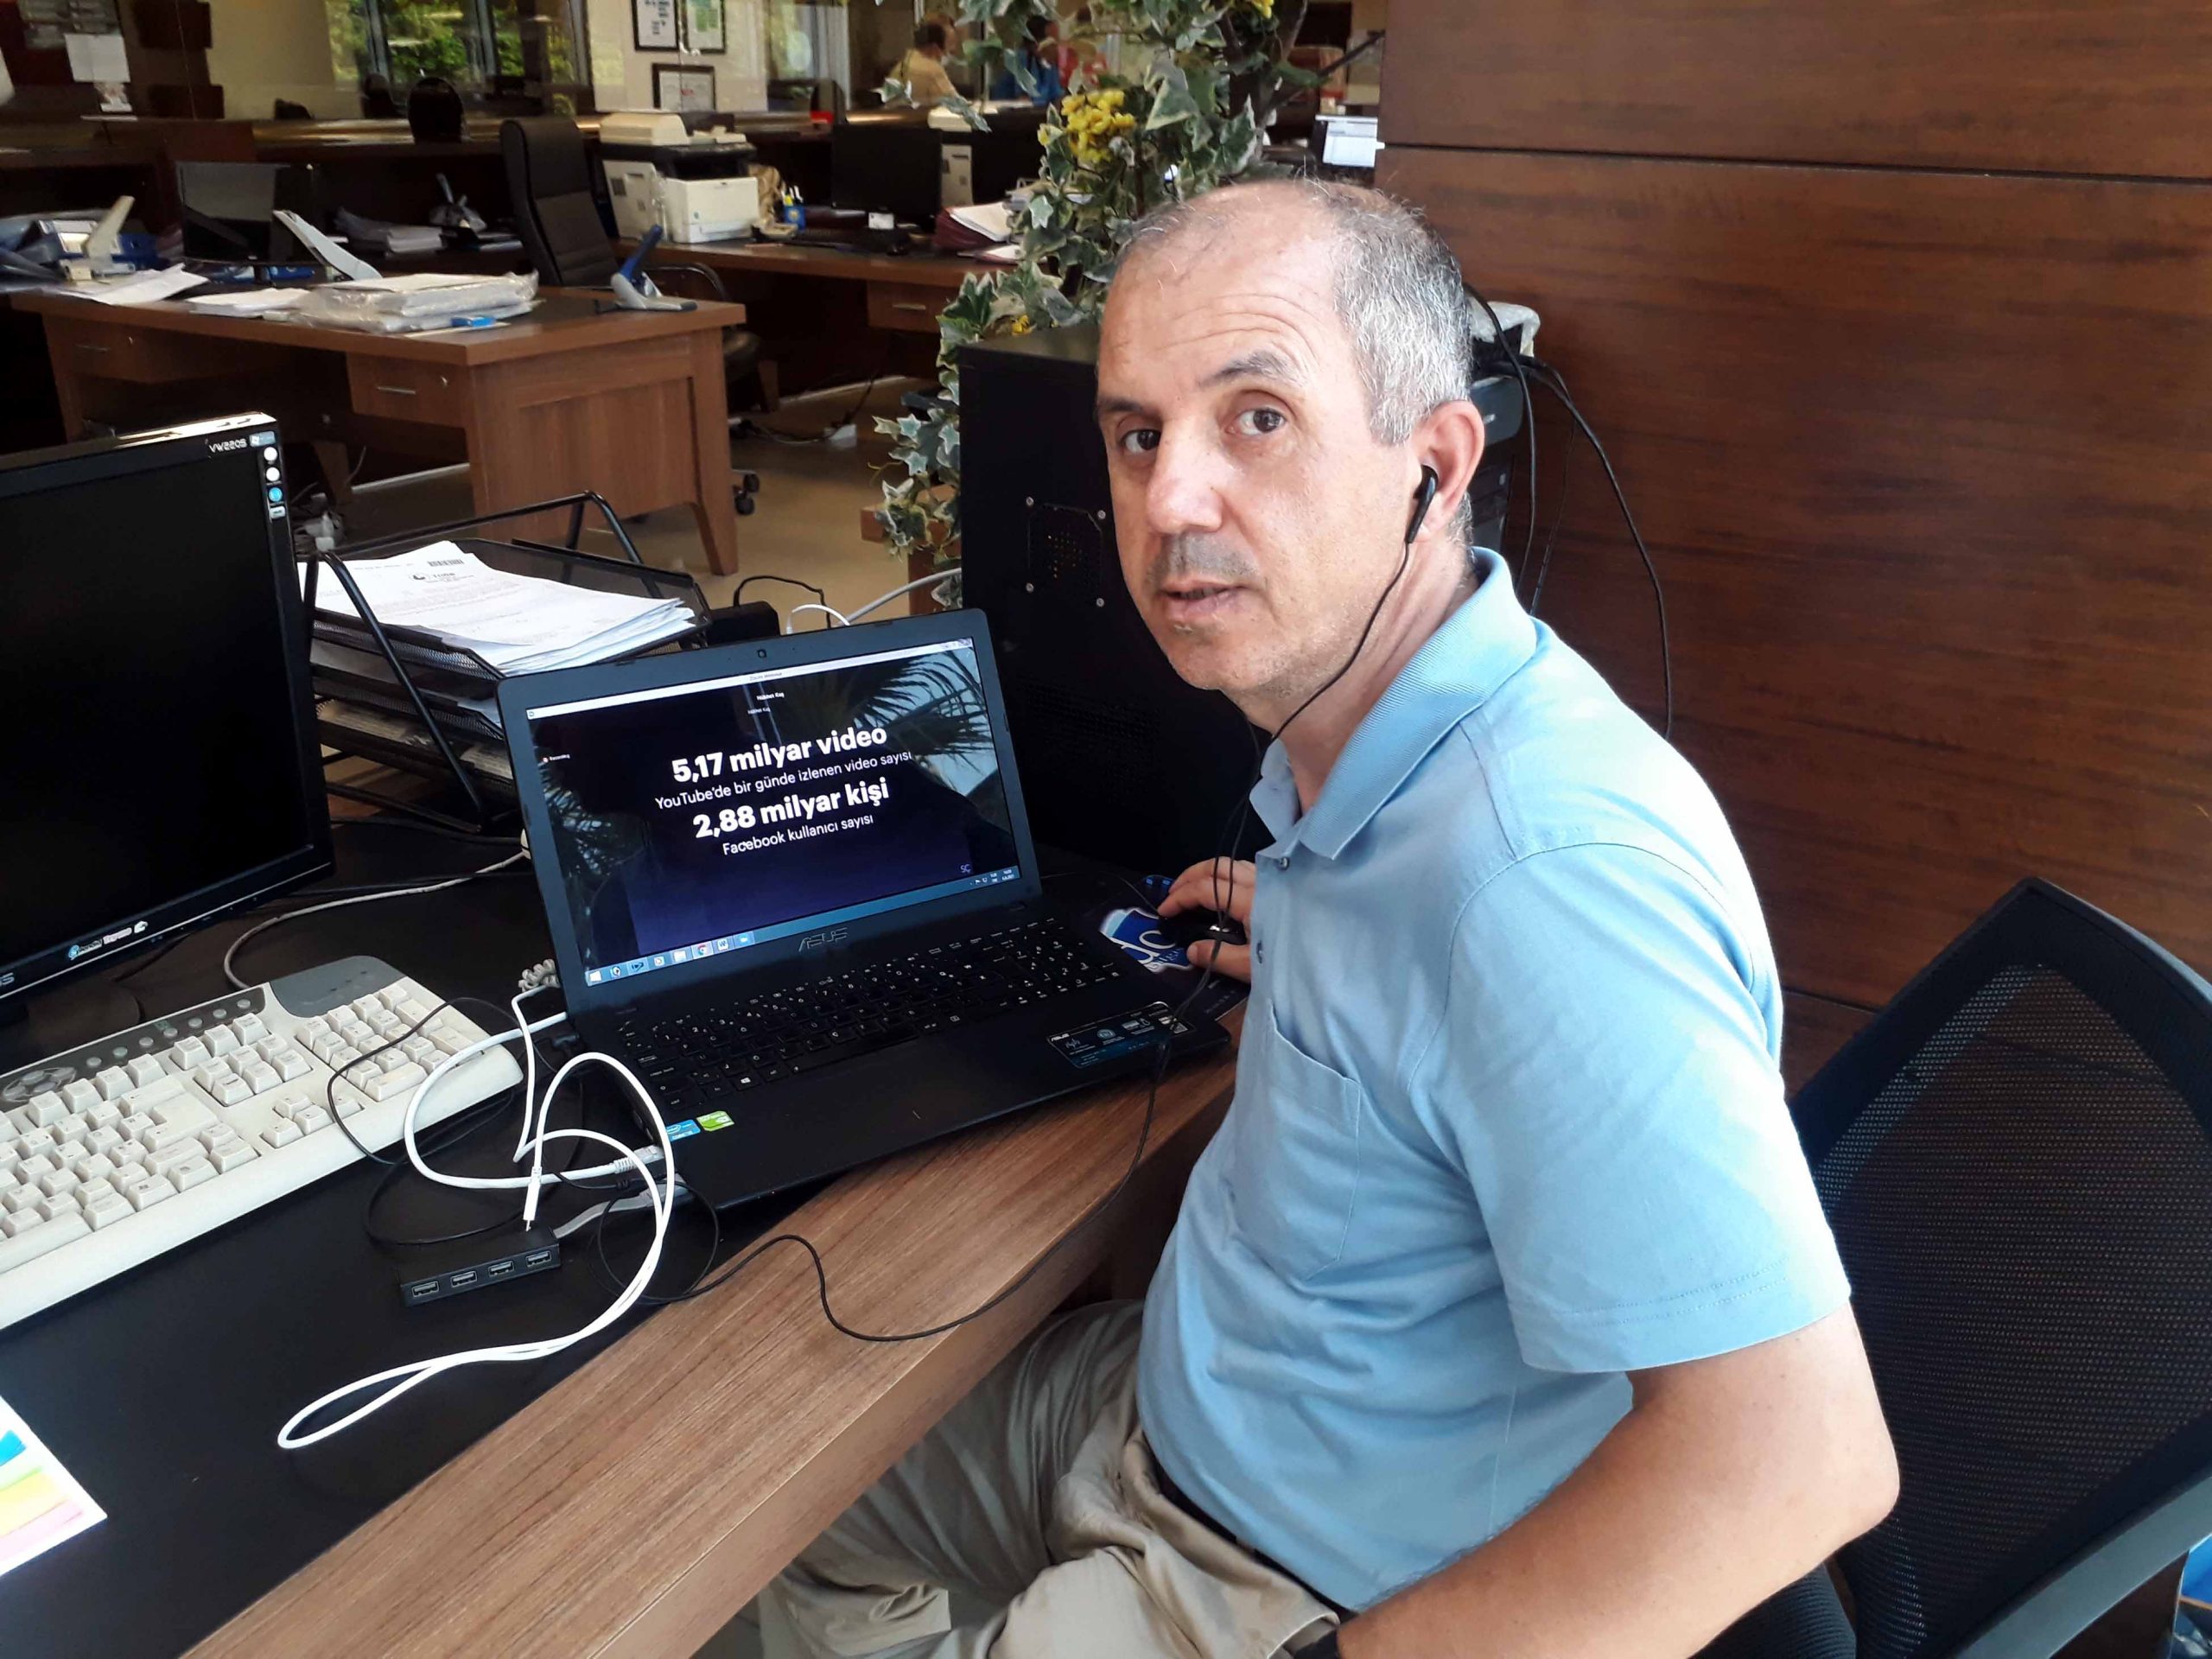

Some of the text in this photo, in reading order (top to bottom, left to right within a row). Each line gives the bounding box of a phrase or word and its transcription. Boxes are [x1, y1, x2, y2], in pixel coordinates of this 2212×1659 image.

[671, 727, 887, 784] 5,17 milyar video
[734, 780, 753, 794] bir
[755, 773, 796, 792] günde
[798, 764, 842, 781] izlenen
[844, 757, 878, 773] video
[880, 751, 912, 767] sayısı
[692, 776, 889, 838] 2,88 milyar kişi
[722, 814, 874, 855] Facebook kullanıcı sayısı
[798, 926, 849, 952] ASUS
